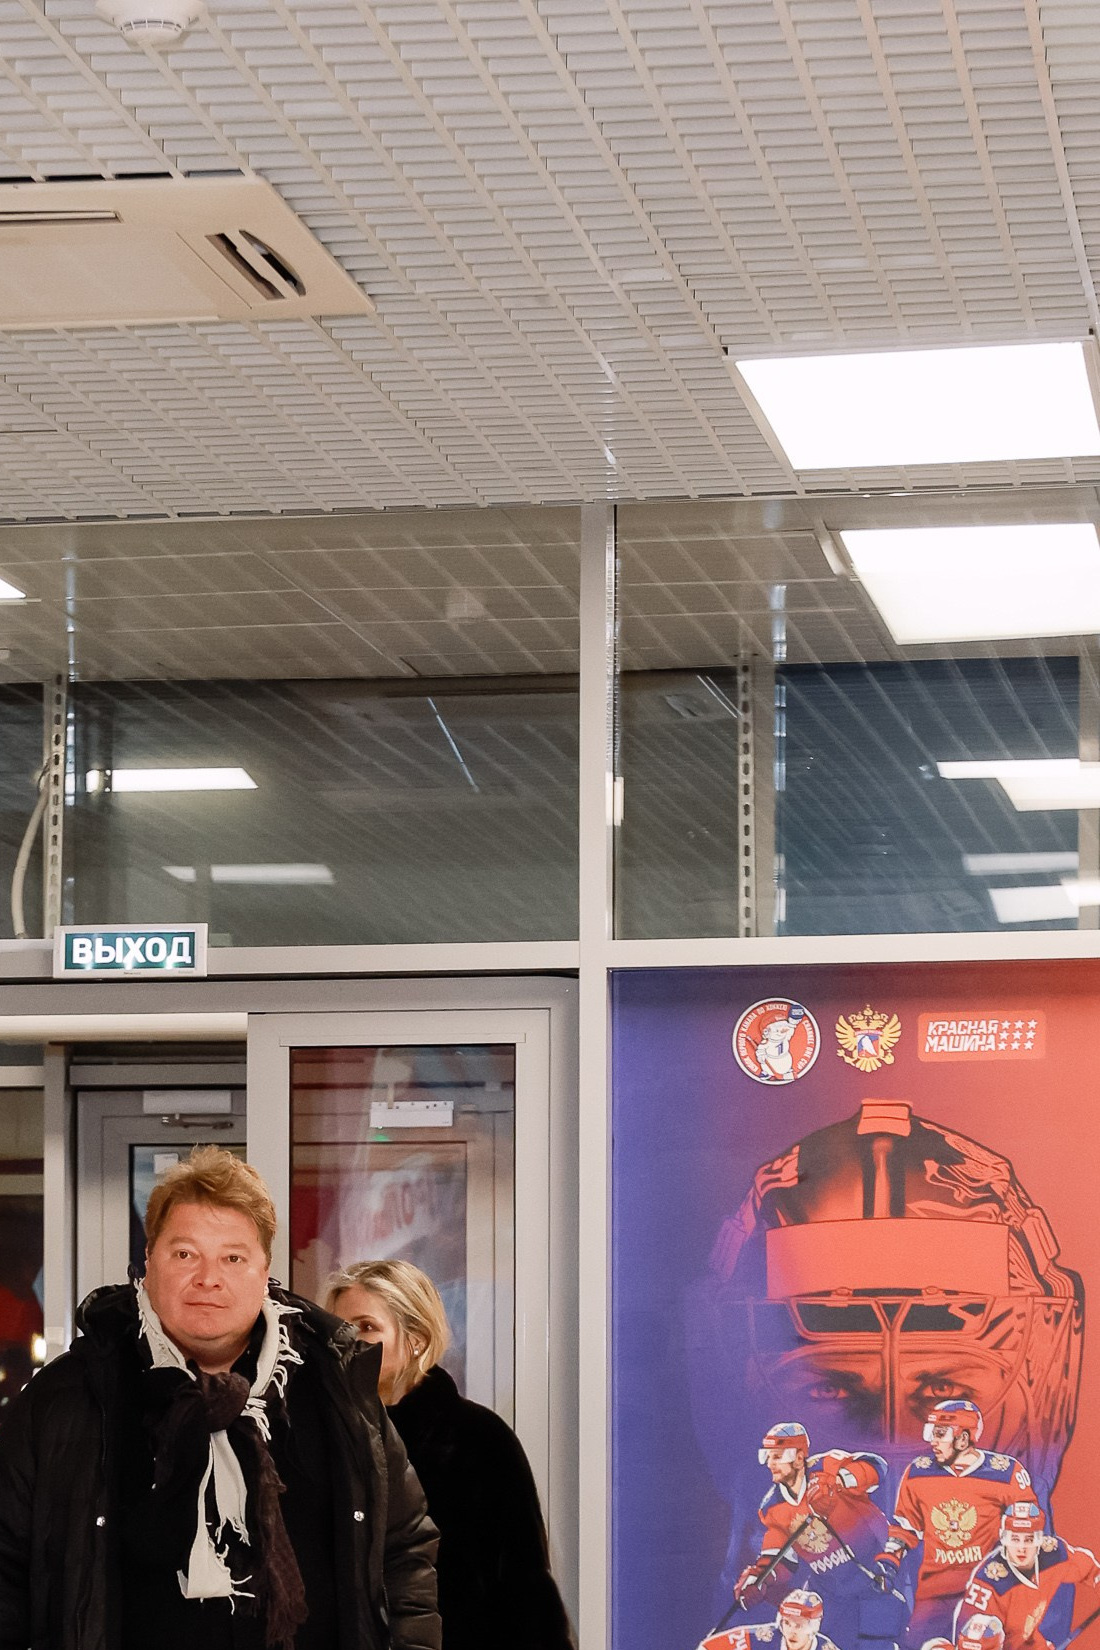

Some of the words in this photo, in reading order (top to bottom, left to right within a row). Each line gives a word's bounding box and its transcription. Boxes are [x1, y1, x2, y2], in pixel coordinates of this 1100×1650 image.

[72, 937, 192, 964] ВЫХОД
[927, 1019, 999, 1036] КРАСНАЯ
[924, 1035, 996, 1053] МАШИНА
[1015, 1468, 1031, 1490] 90
[934, 1545, 982, 1565] РОССИЯ
[964, 1583, 993, 1612] 53
